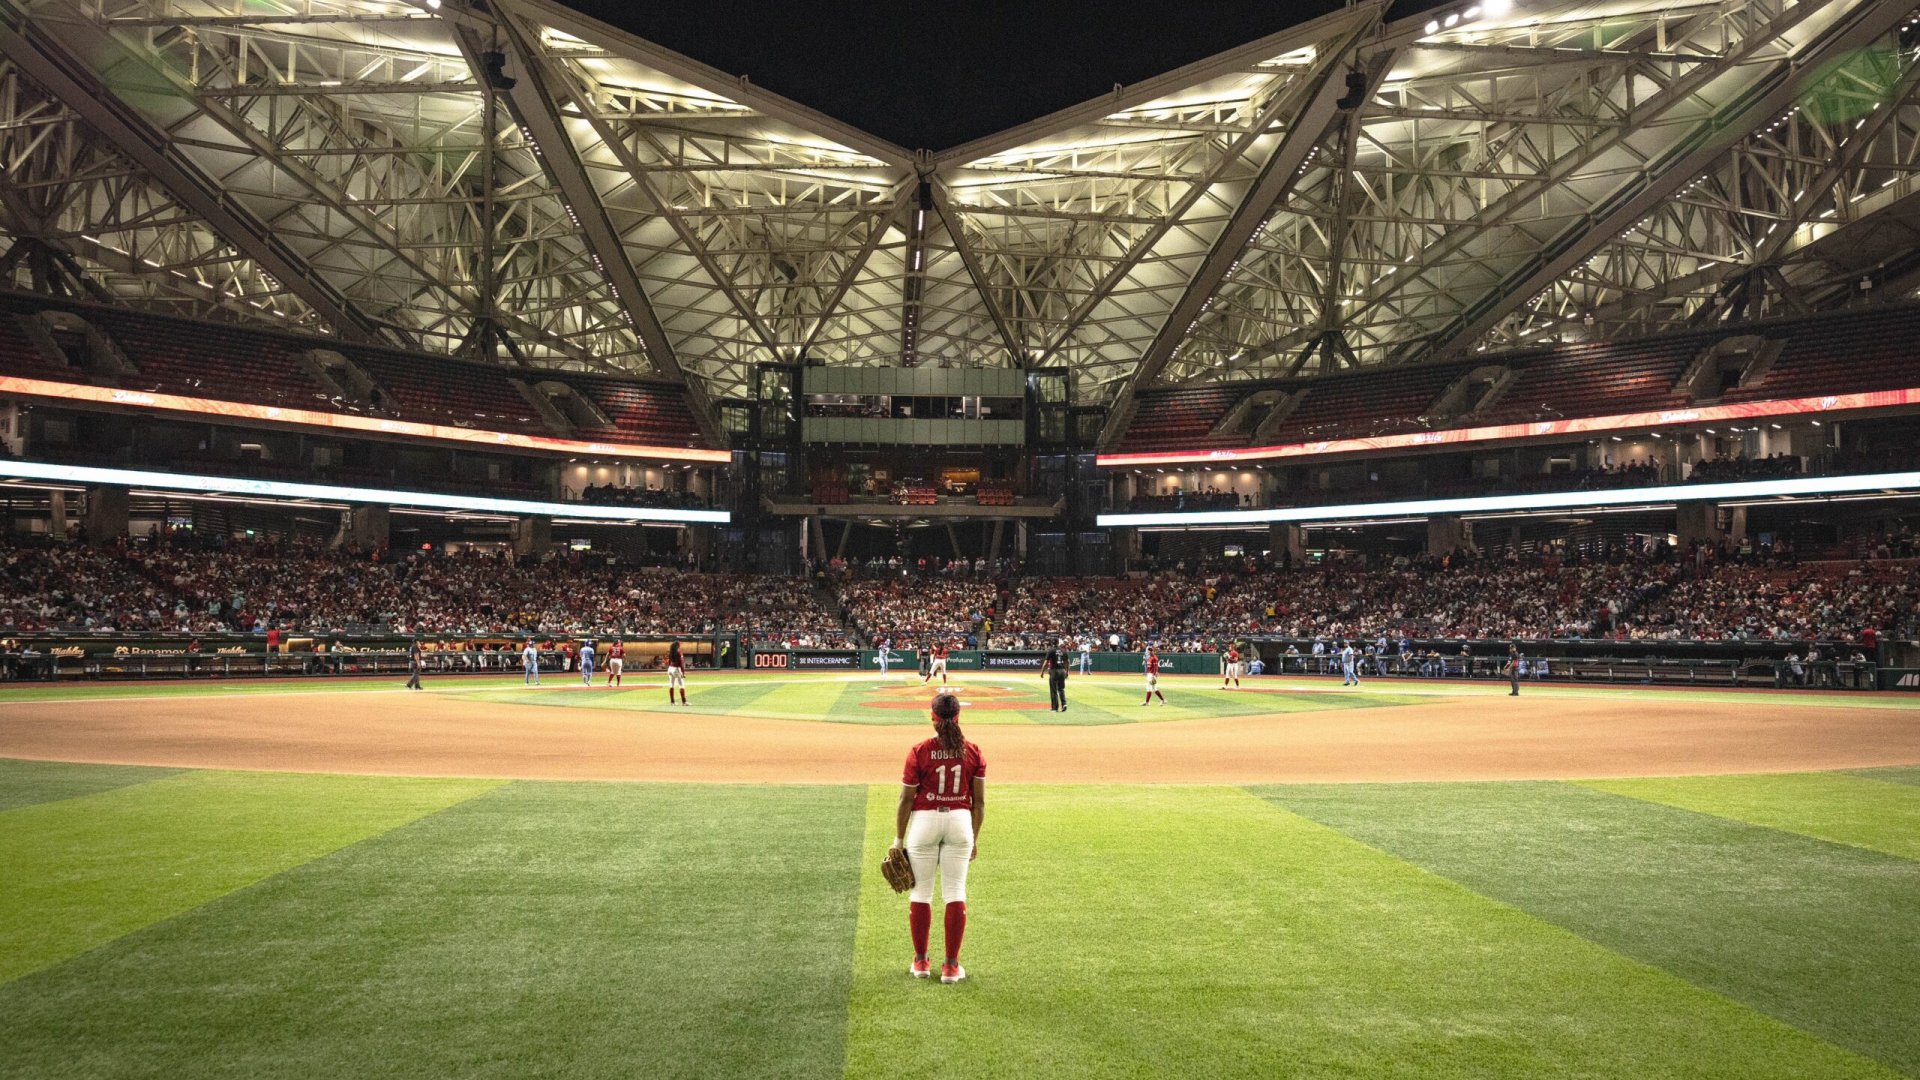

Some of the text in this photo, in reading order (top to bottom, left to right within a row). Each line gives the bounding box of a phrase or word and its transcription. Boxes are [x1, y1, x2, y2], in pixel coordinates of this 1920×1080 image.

[754, 654, 787, 667] 00:00
[996, 658, 1041, 666] INTERCERAMIC
[1157, 658, 1174, 668] Cola
[935, 764, 962, 794] 11
